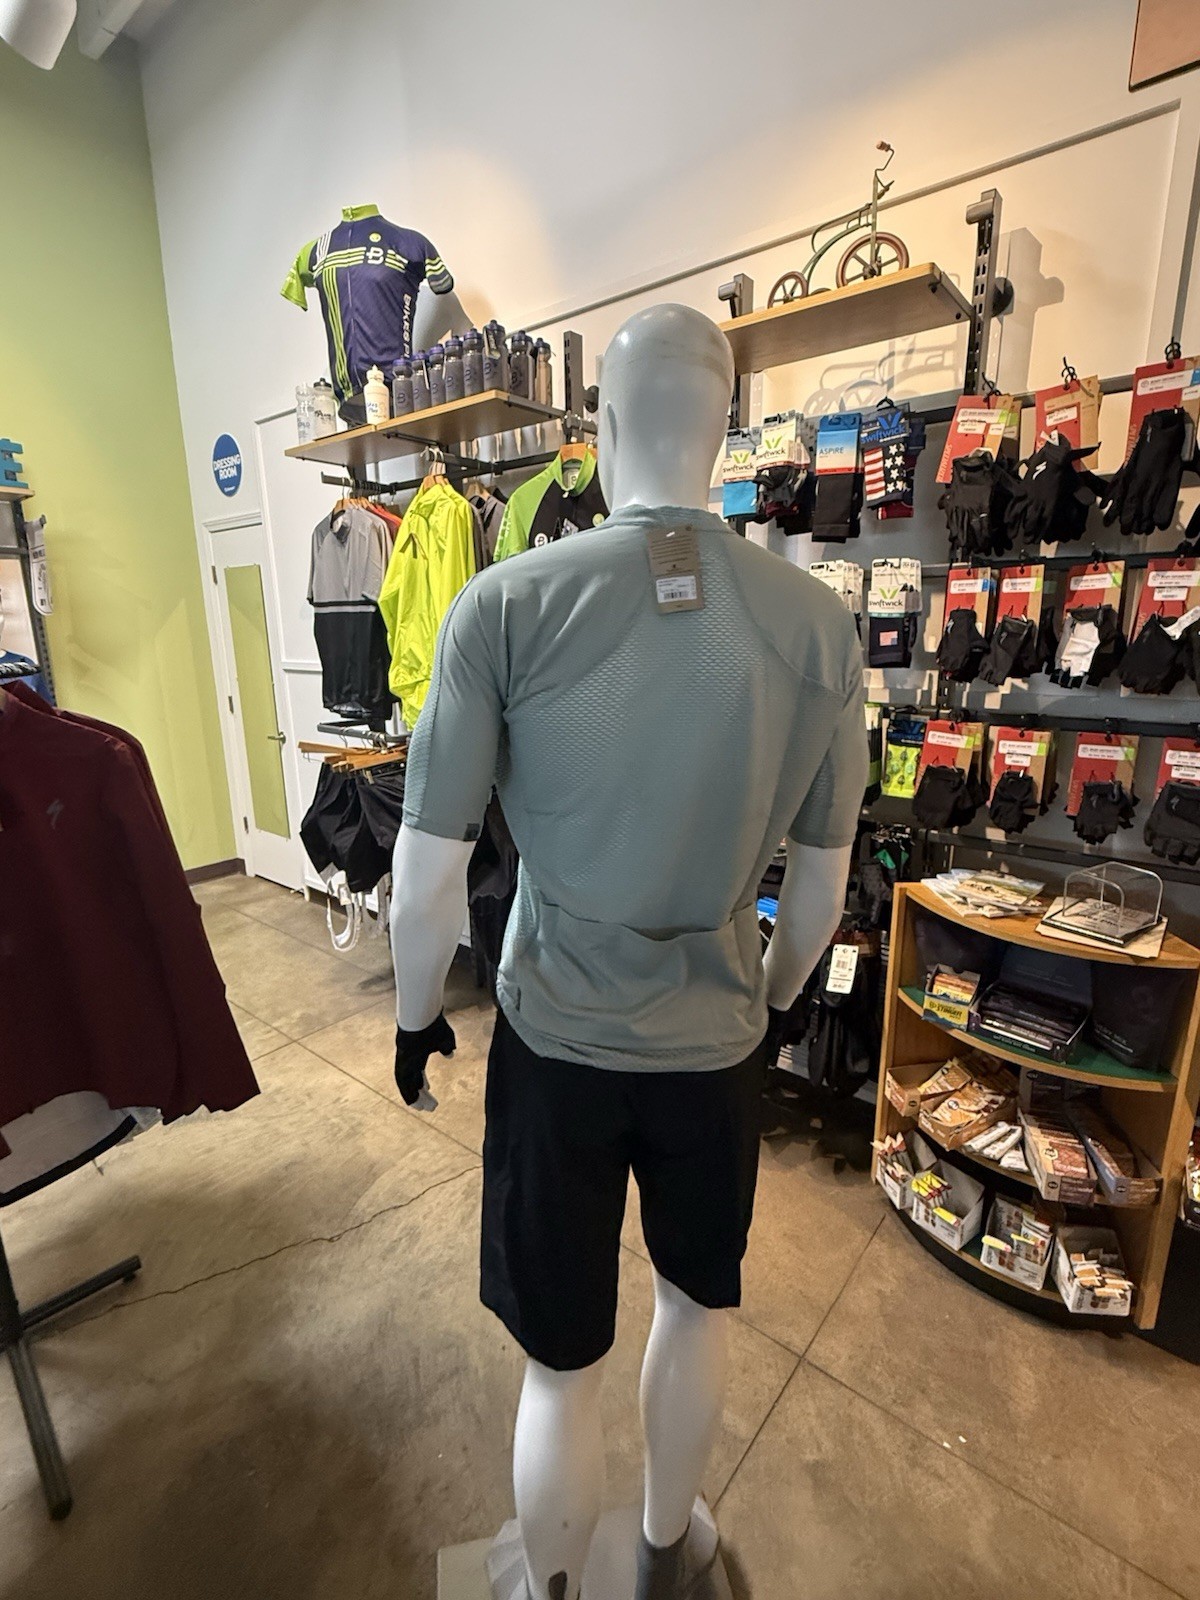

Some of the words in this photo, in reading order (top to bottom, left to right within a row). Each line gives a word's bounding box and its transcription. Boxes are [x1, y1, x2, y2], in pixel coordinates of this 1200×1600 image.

[861, 425, 906, 444] swiftwick
[756, 447, 786, 461] swiftwick
[819, 447, 844, 455] ASPIRE
[213, 454, 240, 471] DRESSING
[723, 463, 754, 473] swiftwick
[219, 466, 237, 480] ROOM
[869, 600, 903, 608] swiftwick
